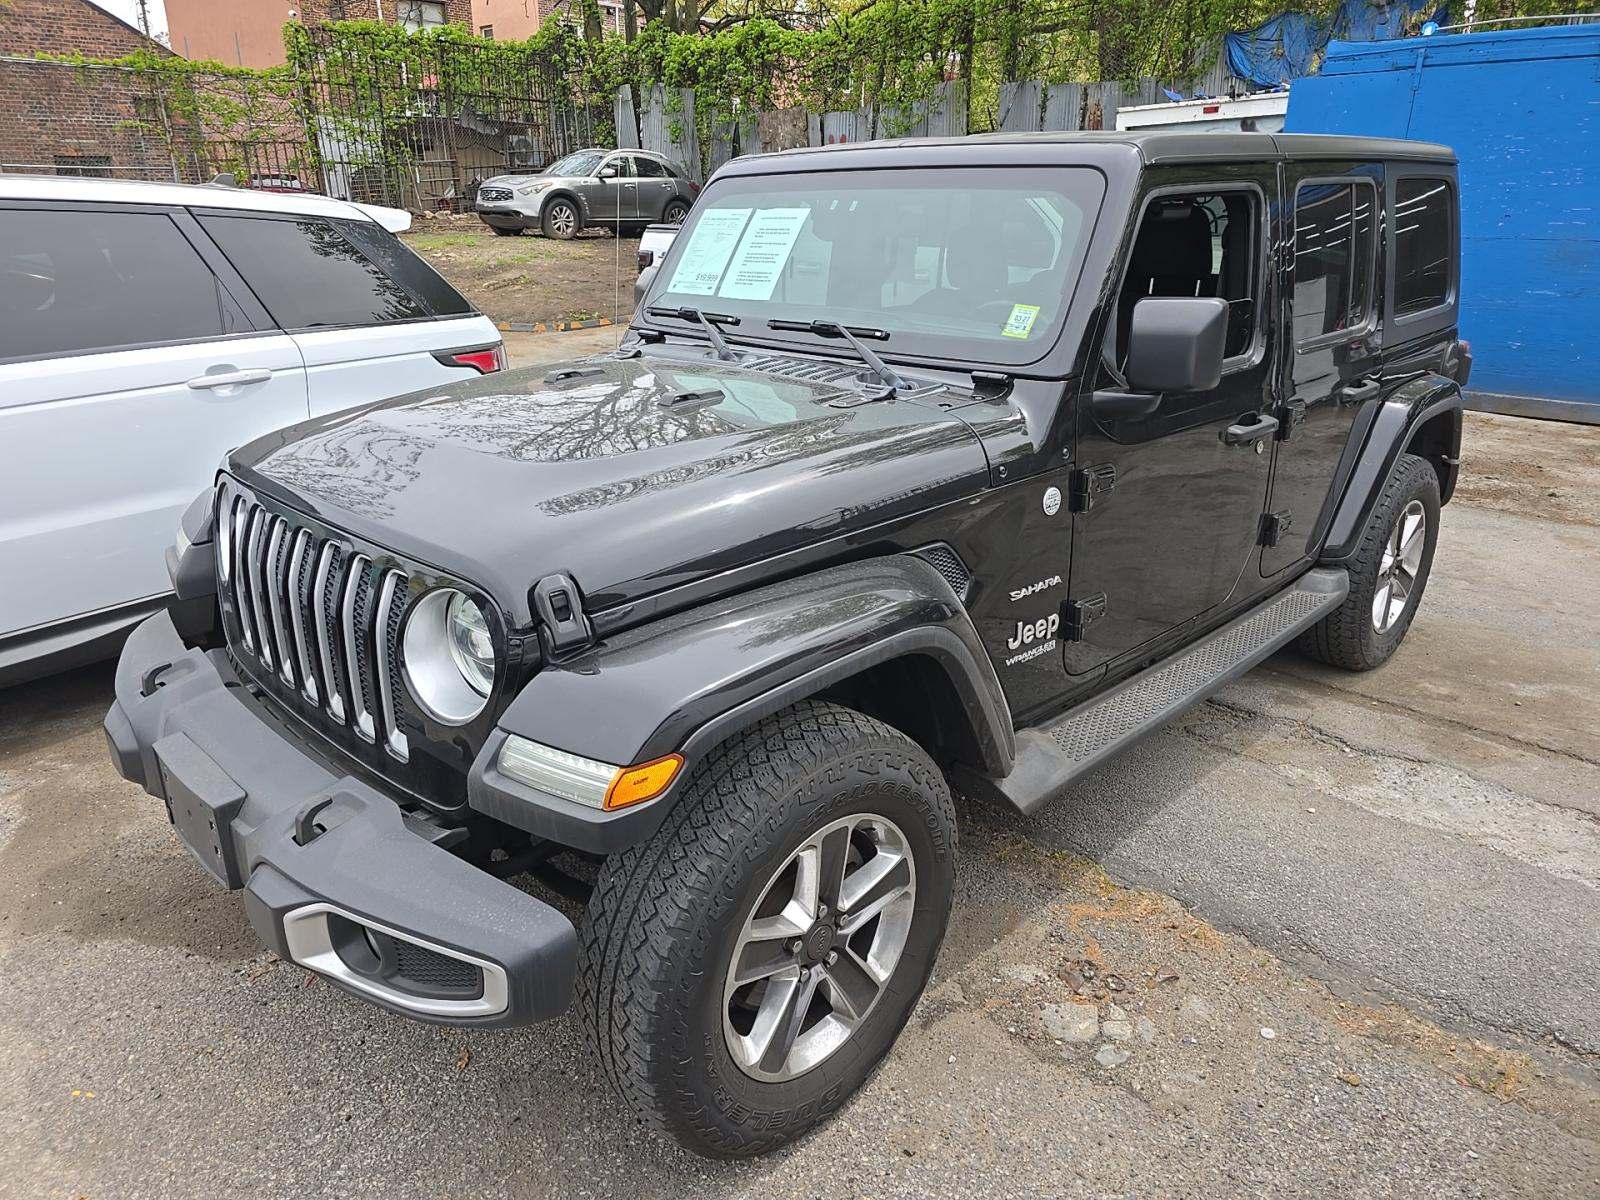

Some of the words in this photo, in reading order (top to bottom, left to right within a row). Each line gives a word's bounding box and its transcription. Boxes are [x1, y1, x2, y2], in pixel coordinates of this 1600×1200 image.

[1008, 575, 1063, 602] SAHARA
[1007, 612, 1060, 650] Jeep
[1005, 639, 1056, 667] WRANGLER
[803, 779, 947, 863] BRIDGESTONE
